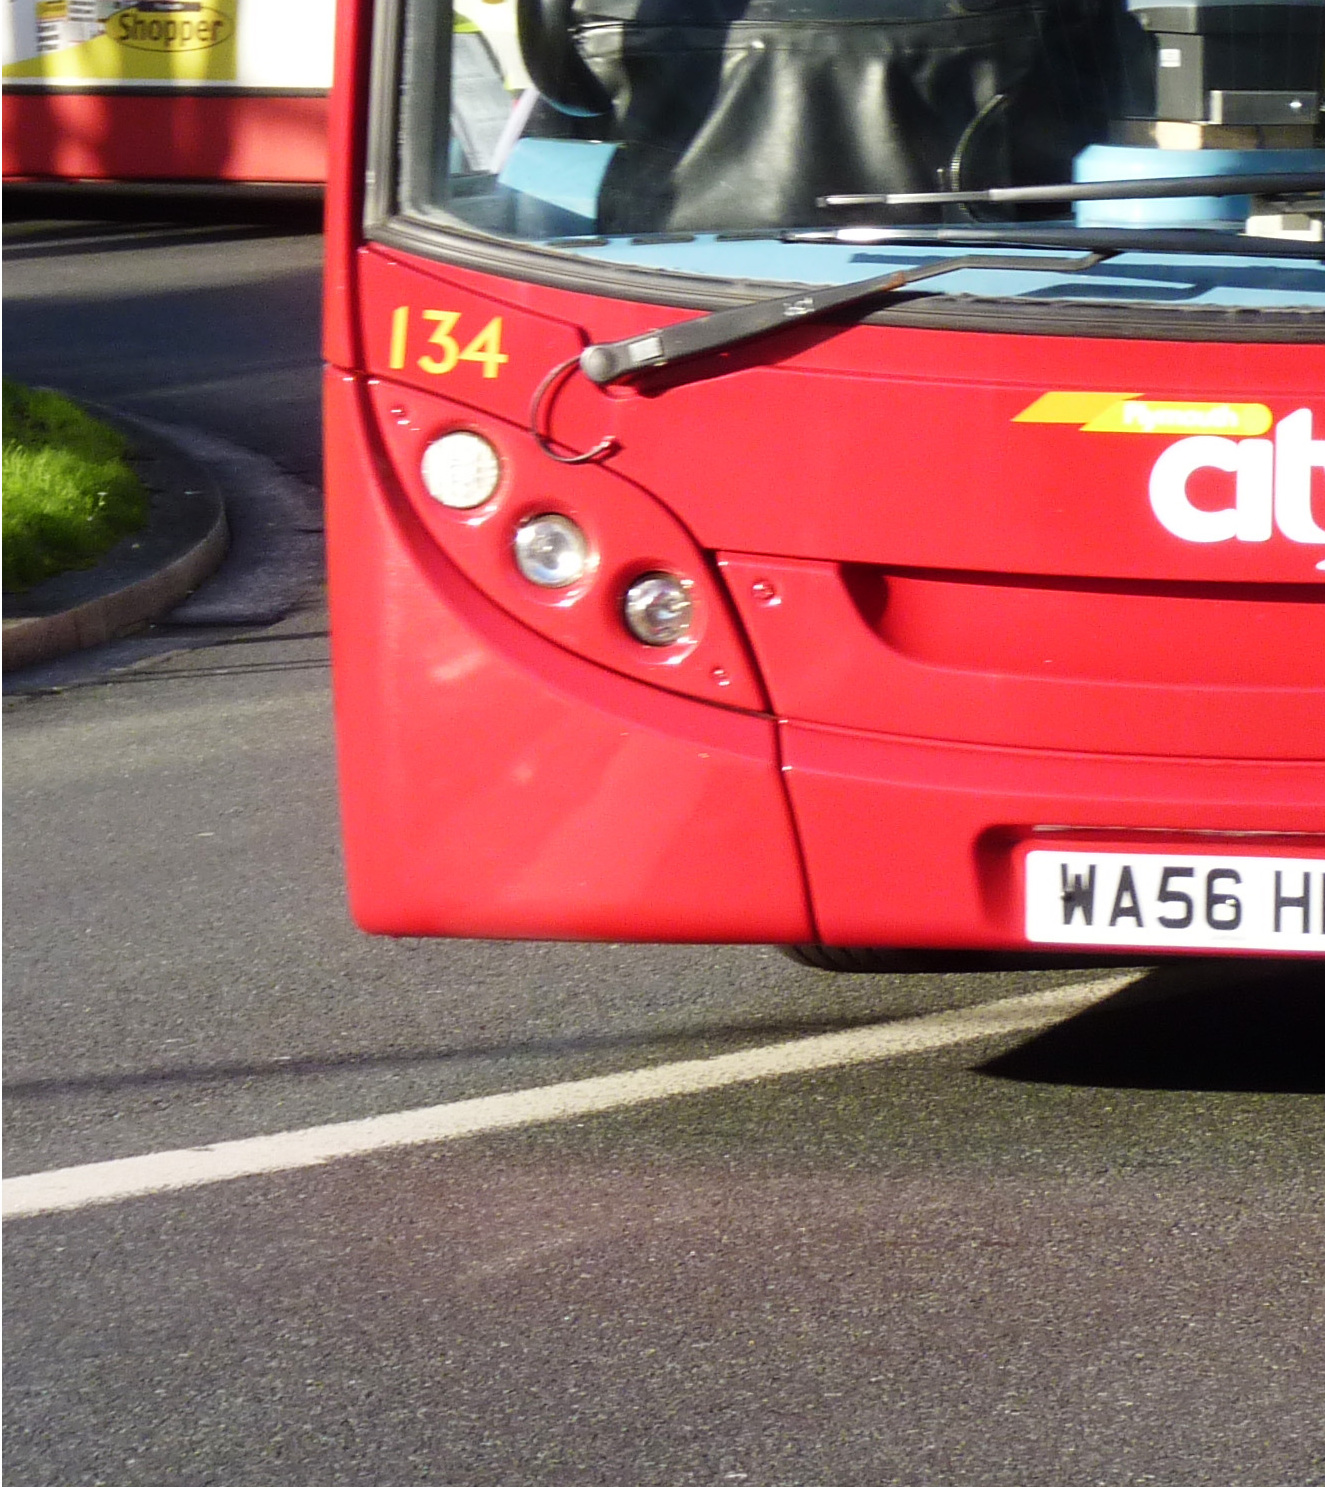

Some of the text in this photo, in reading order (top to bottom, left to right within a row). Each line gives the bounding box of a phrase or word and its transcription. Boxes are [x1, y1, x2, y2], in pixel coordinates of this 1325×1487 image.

[118, 12, 224, 48] Shopper
[388, 305, 510, 379] 134
[1059, 862, 1244, 932] WA56
